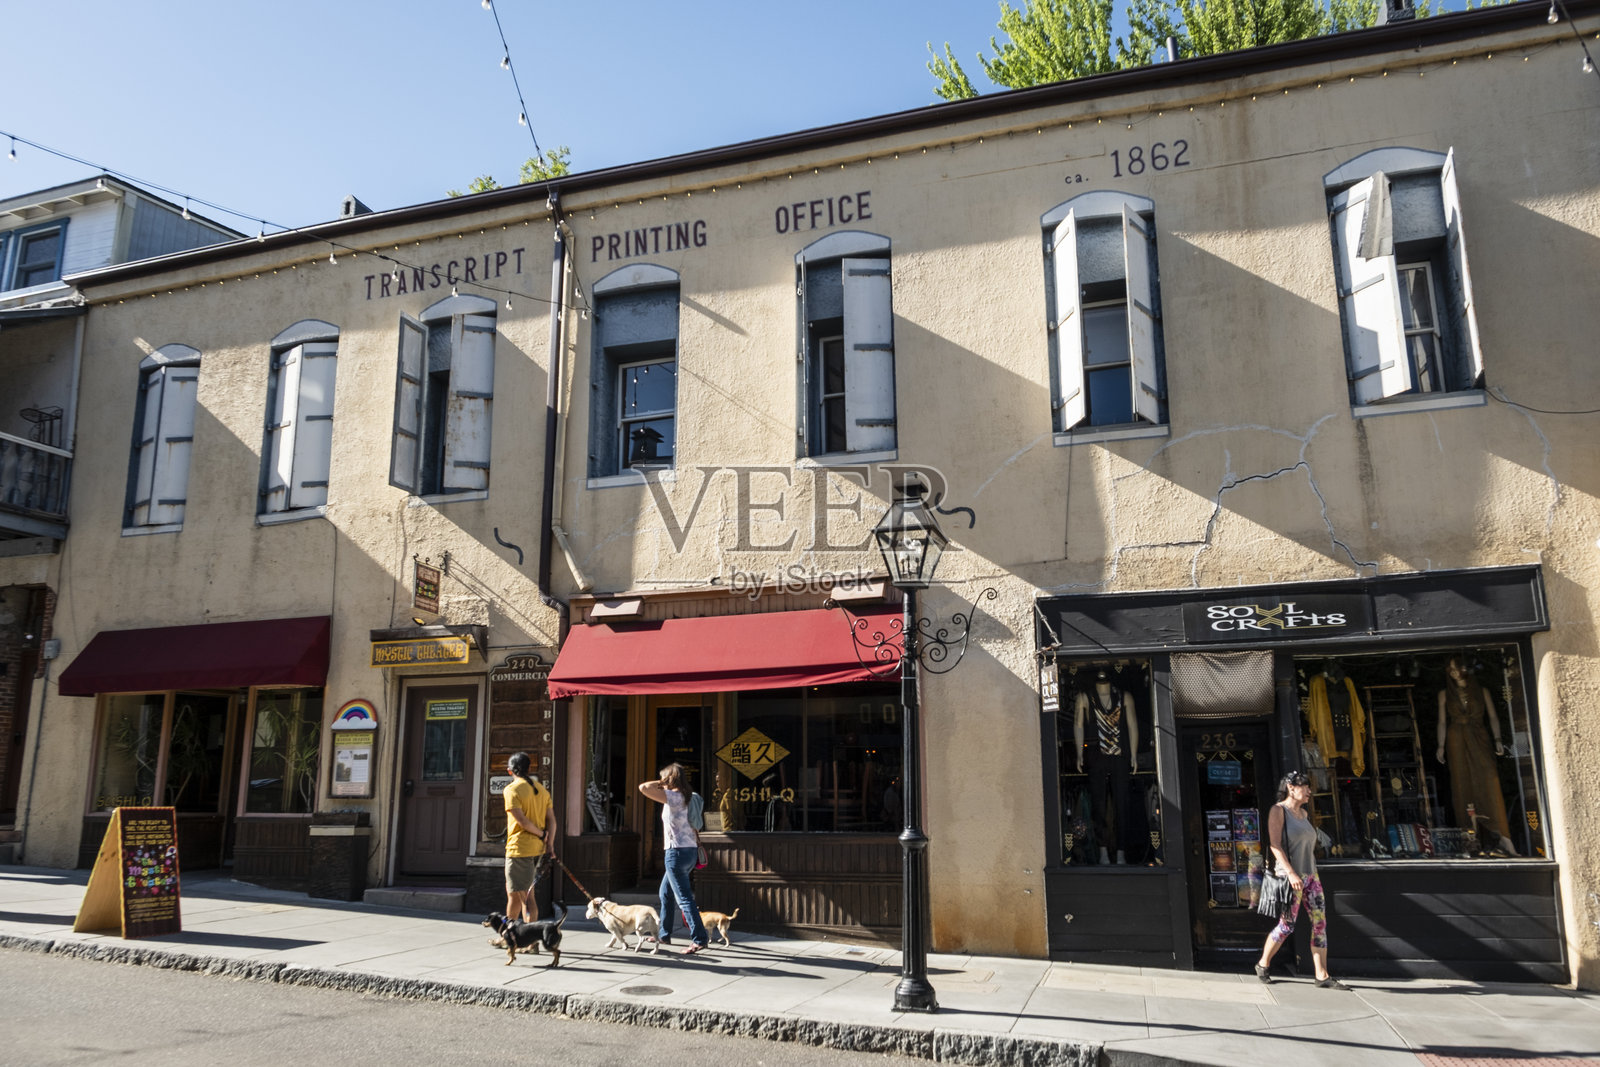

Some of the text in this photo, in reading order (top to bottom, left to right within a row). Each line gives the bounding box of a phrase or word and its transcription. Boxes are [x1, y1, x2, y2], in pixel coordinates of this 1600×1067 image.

[1065, 139, 1190, 184] ca. 1862
[364, 190, 873, 300] TRANSCRIPT PRINTING OFFICE
[375, 642, 464, 662] MYSTIC THEATER
[511, 658, 535, 670] 240
[491, 671, 548, 681] COMMERCIA
[543, 710, 552, 719] B
[542, 733, 551, 742] C
[1201, 733, 1237, 750] 236
[542, 756, 551, 766] D
